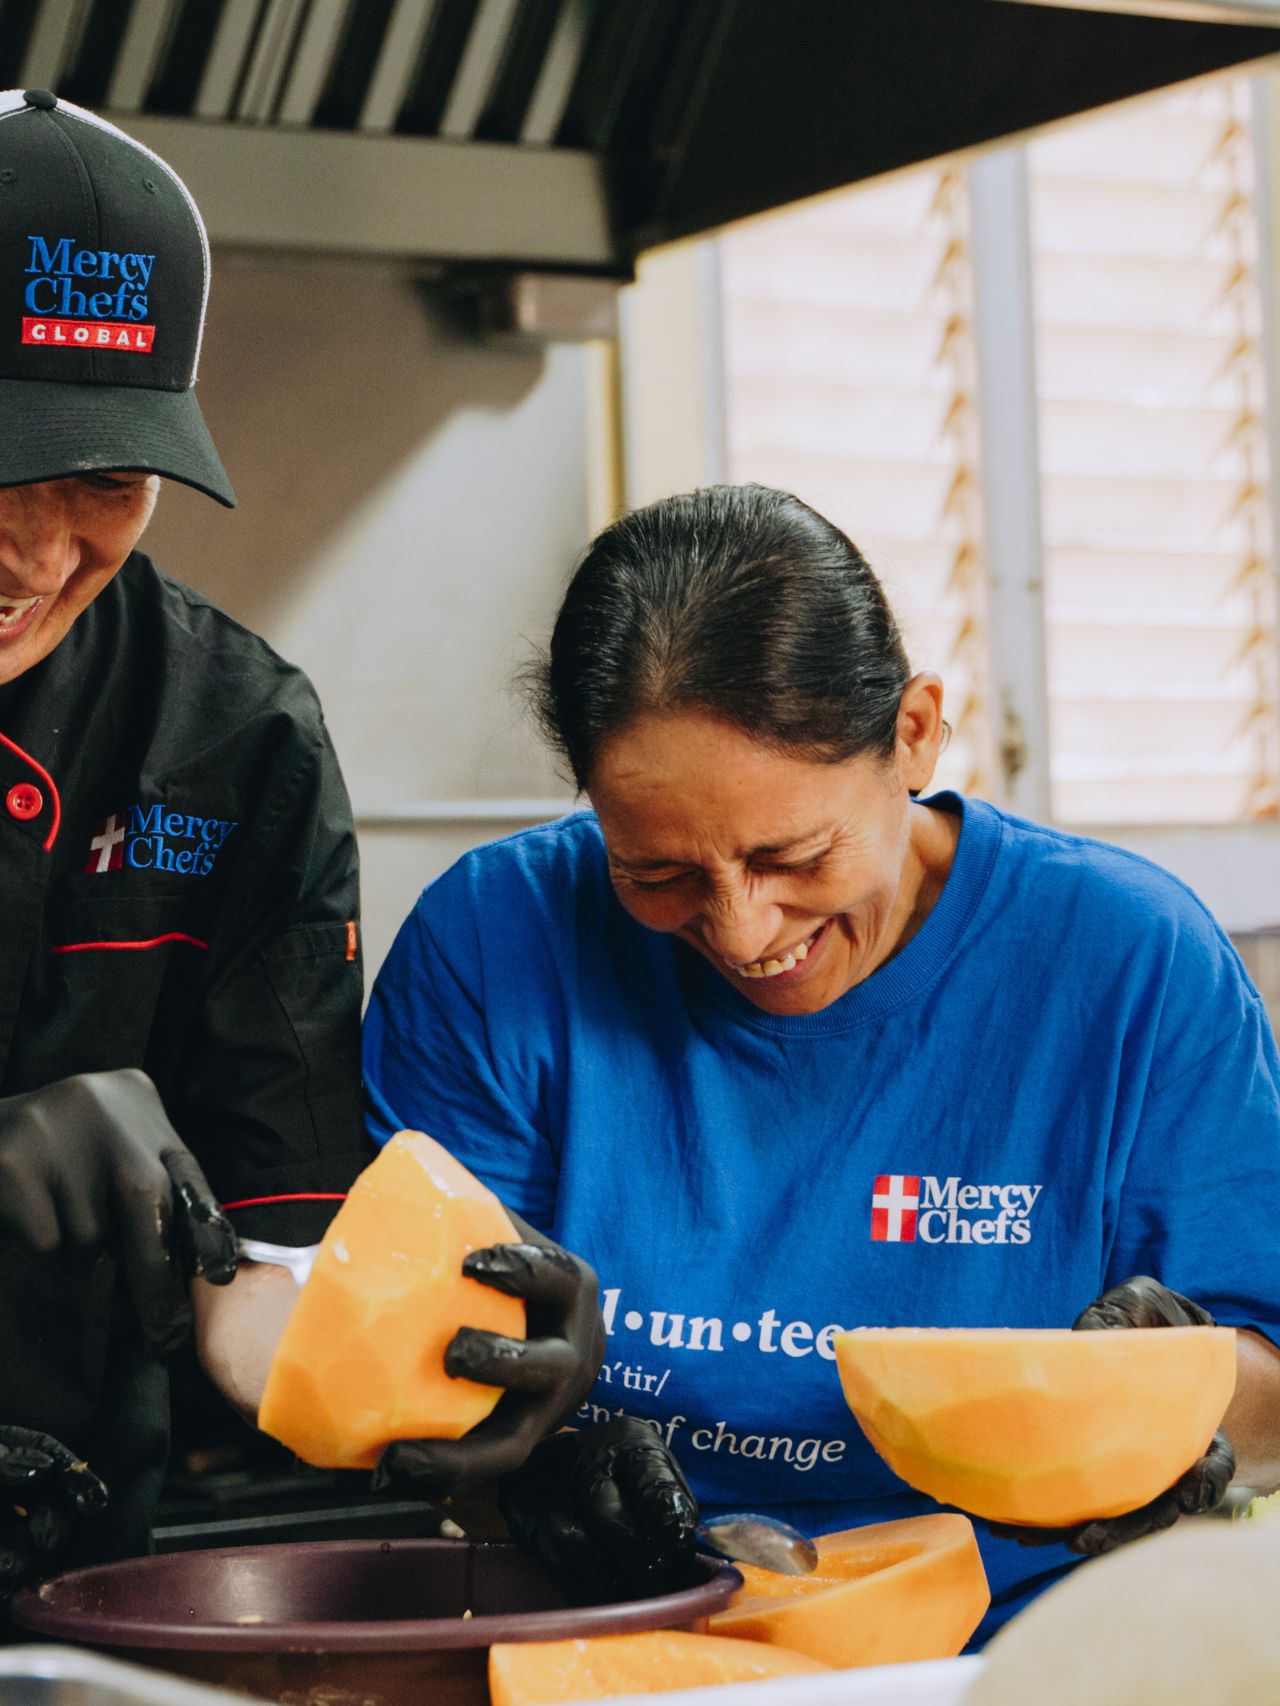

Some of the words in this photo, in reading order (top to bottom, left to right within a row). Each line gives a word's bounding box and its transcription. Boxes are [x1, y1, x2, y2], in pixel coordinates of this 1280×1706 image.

[24, 235, 156, 291] Mercy
[25, 277, 148, 321] Chefs
[31, 324, 148, 347] GLOBAL
[126, 804, 238, 850] Mercy
[126, 836, 218, 876] Chefs
[919, 1176, 1043, 1218] Mercy
[918, 1208, 1032, 1245] Chefs
[690, 1421, 847, 1471] change
